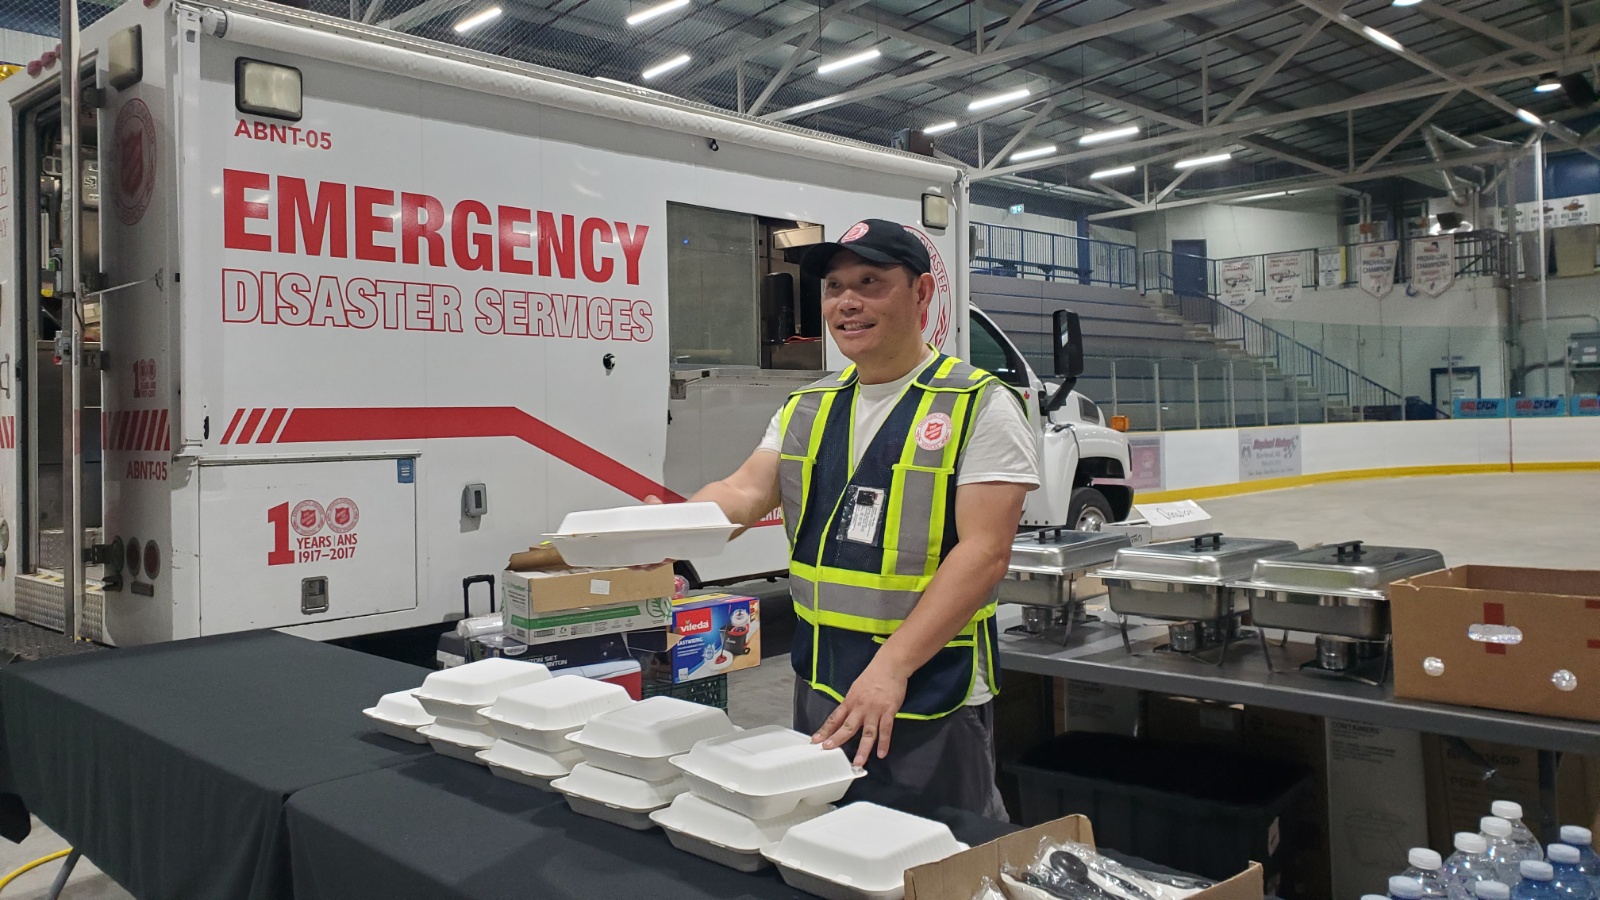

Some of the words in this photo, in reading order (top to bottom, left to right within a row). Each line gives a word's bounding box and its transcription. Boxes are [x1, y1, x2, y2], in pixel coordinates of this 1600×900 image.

[234, 118, 332, 150] ABNT-05
[223, 168, 649, 286] EMERGENCY
[221, 268, 463, 333] DISASTER
[475, 287, 653, 342] SERVICES
[127, 461, 168, 481] ABNT-05
[297, 535, 332, 550] YEARS
[337, 533, 358, 547] ANS
[680, 619, 709, 632] vileda
